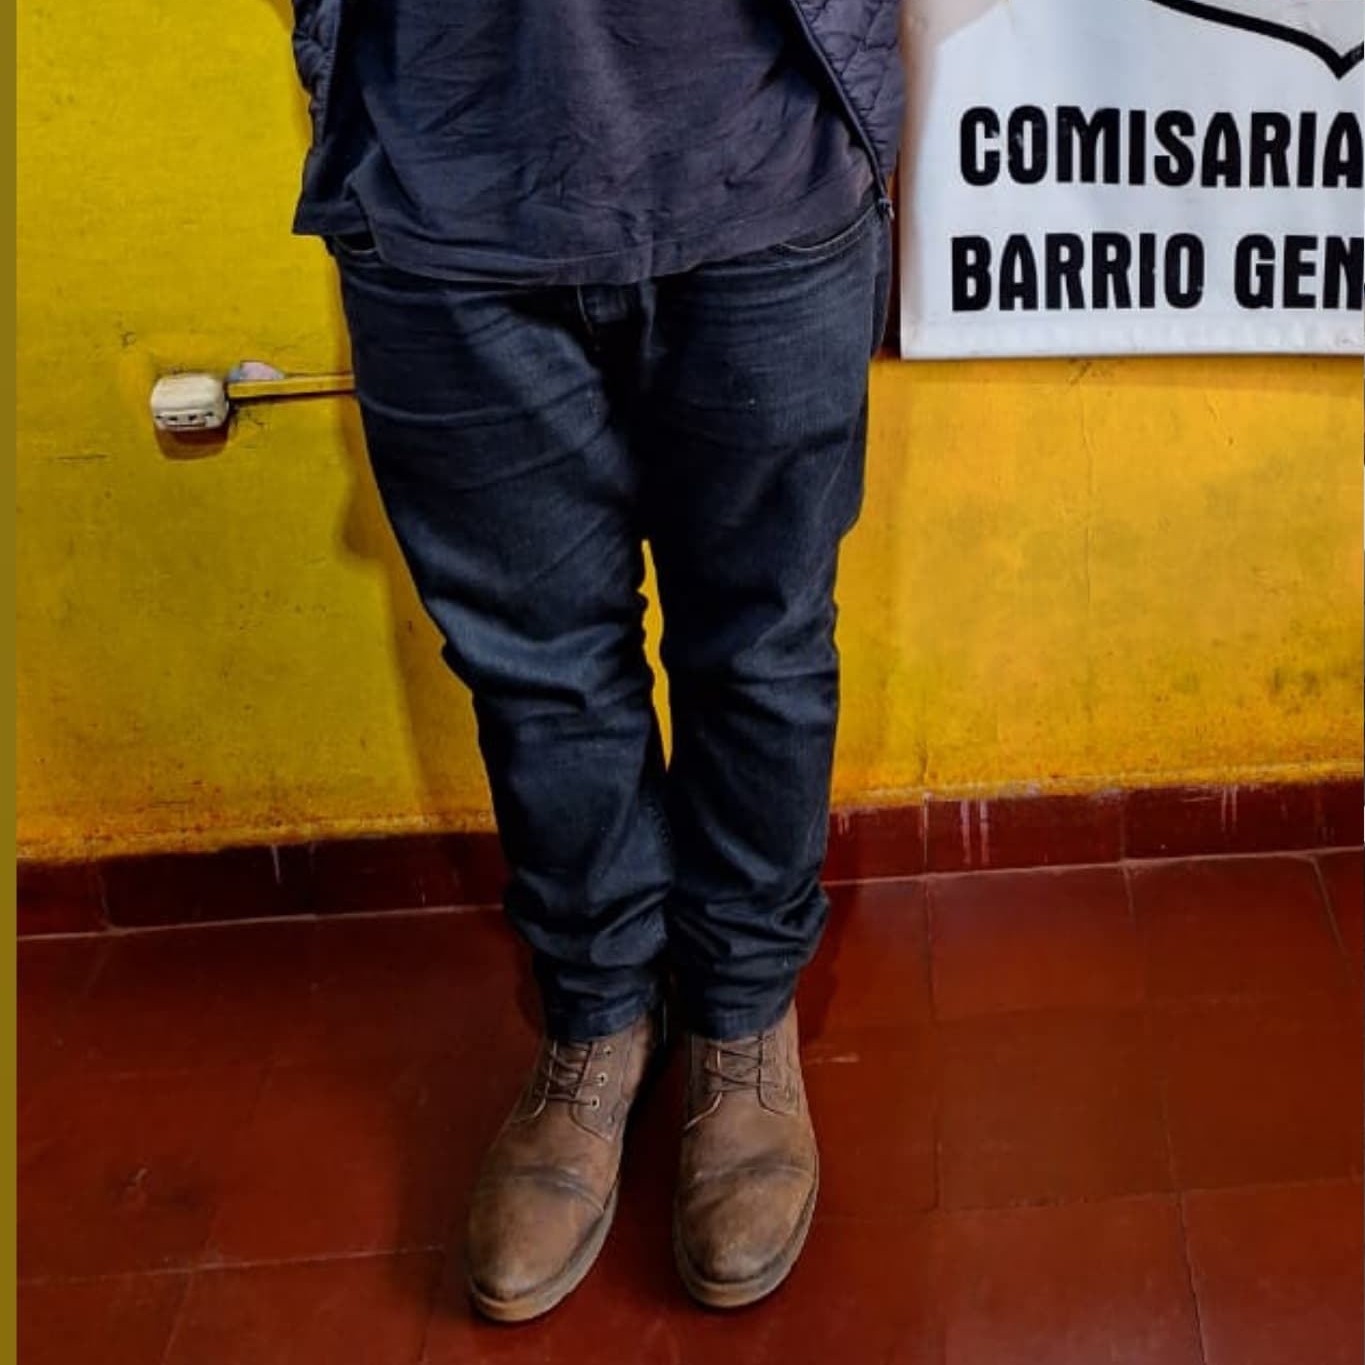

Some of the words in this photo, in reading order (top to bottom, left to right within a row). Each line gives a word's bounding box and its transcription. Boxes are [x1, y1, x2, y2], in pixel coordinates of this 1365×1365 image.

[959, 104, 1364, 189] COMISARIA
[951, 231, 1206, 312] BARRIO
[1234, 233, 1364, 311] GEN
